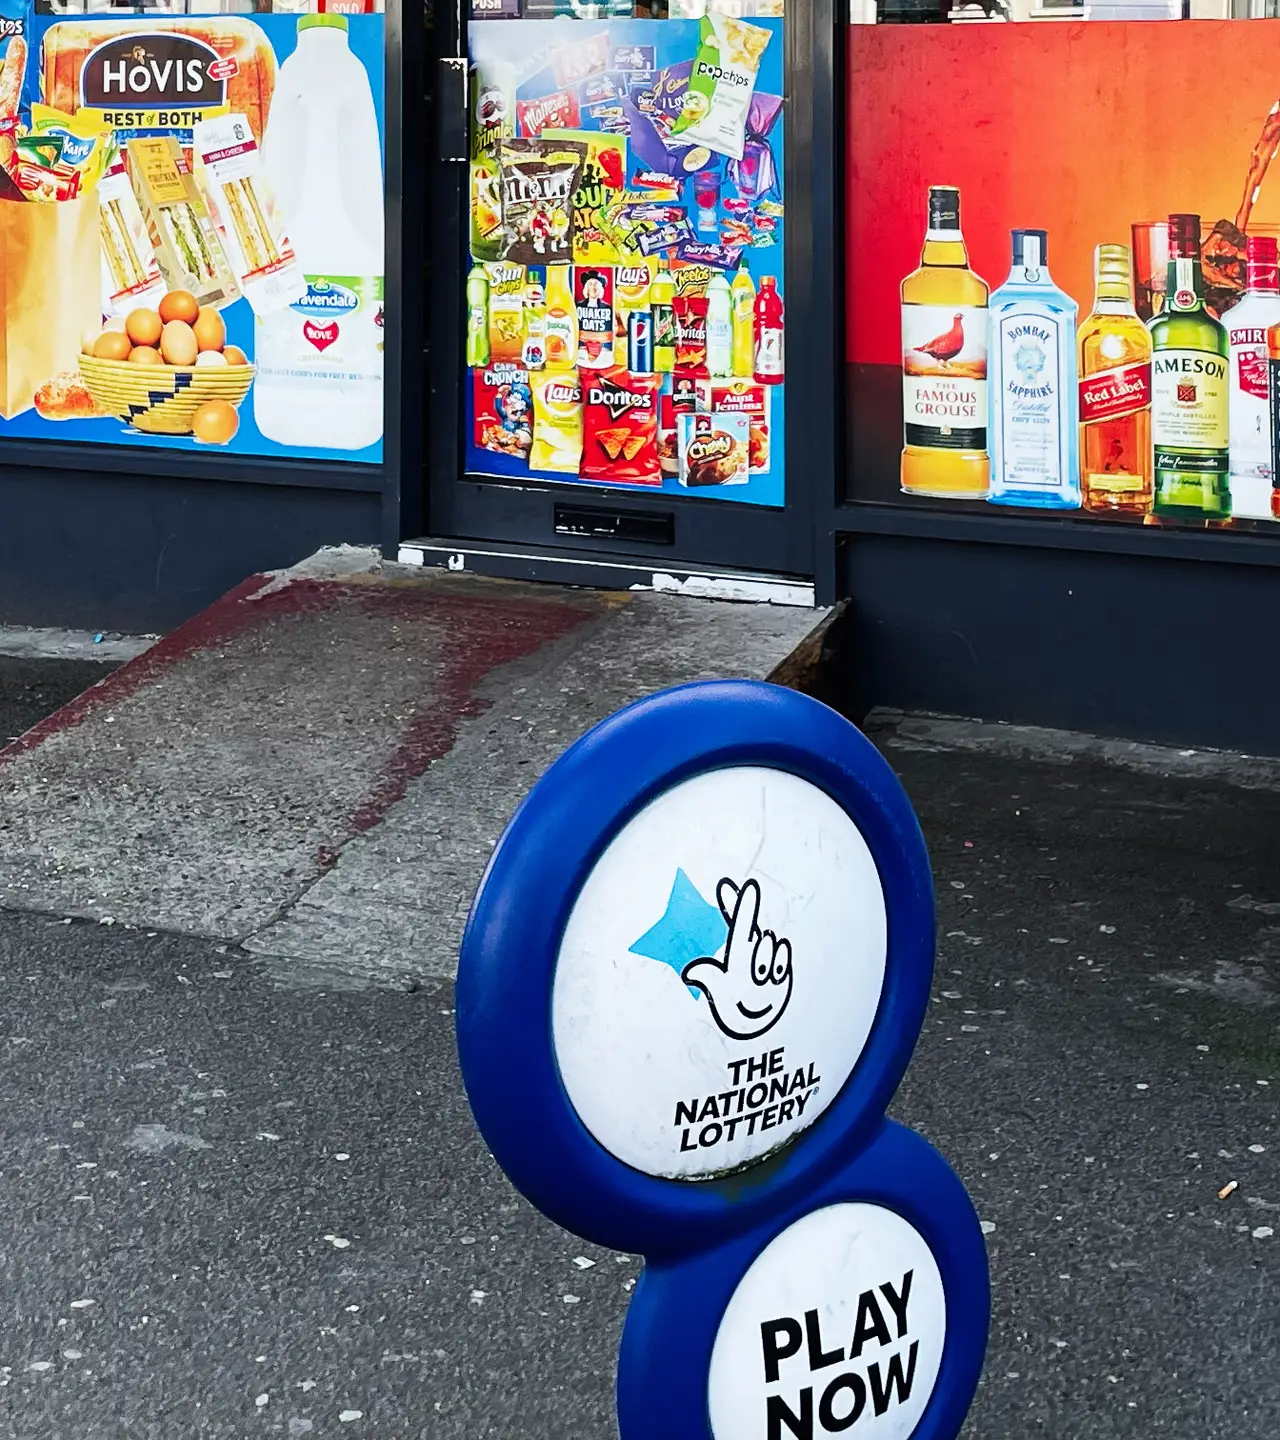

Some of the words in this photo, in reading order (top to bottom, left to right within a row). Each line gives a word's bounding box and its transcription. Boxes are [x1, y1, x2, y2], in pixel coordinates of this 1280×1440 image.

[104, 113, 144, 126] BEST
[159, 112, 202, 126] BOTH
[577, 307, 612, 322] QUAKER
[582, 318, 606, 331] OATS
[1007, 324, 1053, 345] BOMBAY
[483, 369, 529, 385] CRUNCH
[935, 382, 957, 390] THE
[1008, 380, 1055, 399] SAPPHIRE
[1084, 388, 1109, 405] Red
[1110, 377, 1146, 398] Label
[589, 388, 652, 408] Doritos
[723, 393, 754, 404] Aunt
[916, 389, 977, 404] FAMOUS
[714, 402, 763, 412] Jemima
[915, 402, 977, 417] GROUSE
[727, 1046, 786, 1087] THE
[674, 1063, 821, 1129] NATIONAL
[679, 1092, 813, 1153] LOTTERY
[760, 1269, 915, 1384] PLAY
[766, 1339, 923, 1440] NOW
